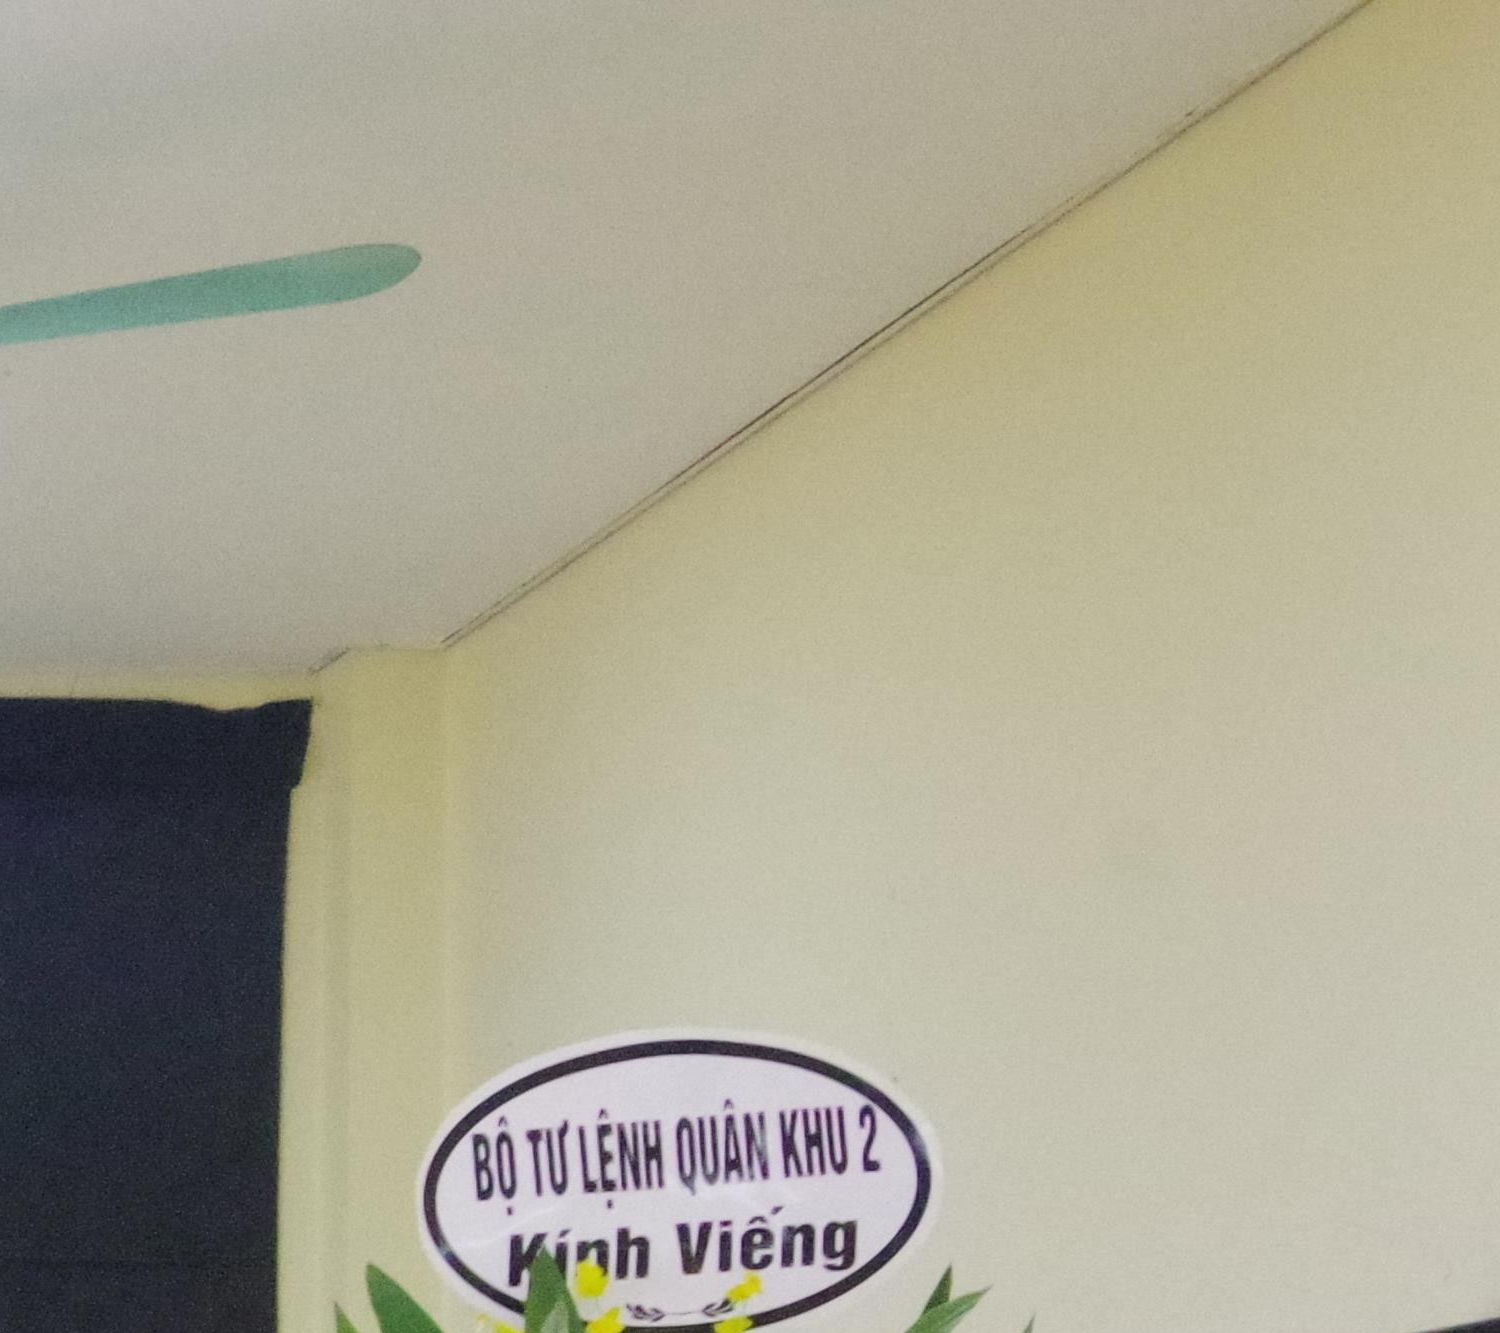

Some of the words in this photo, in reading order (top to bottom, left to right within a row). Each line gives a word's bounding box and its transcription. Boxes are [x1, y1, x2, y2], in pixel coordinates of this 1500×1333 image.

[472, 1116, 517, 1216] BỘ
[526, 1120, 569, 1197] TƯ
[578, 1108, 665, 1209] LỆNH
[675, 1099, 770, 1194] QUÂN
[778, 1106, 849, 1178] KHU
[858, 1104, 881, 1173] 2
[676, 1206, 858, 1272] Viếng
